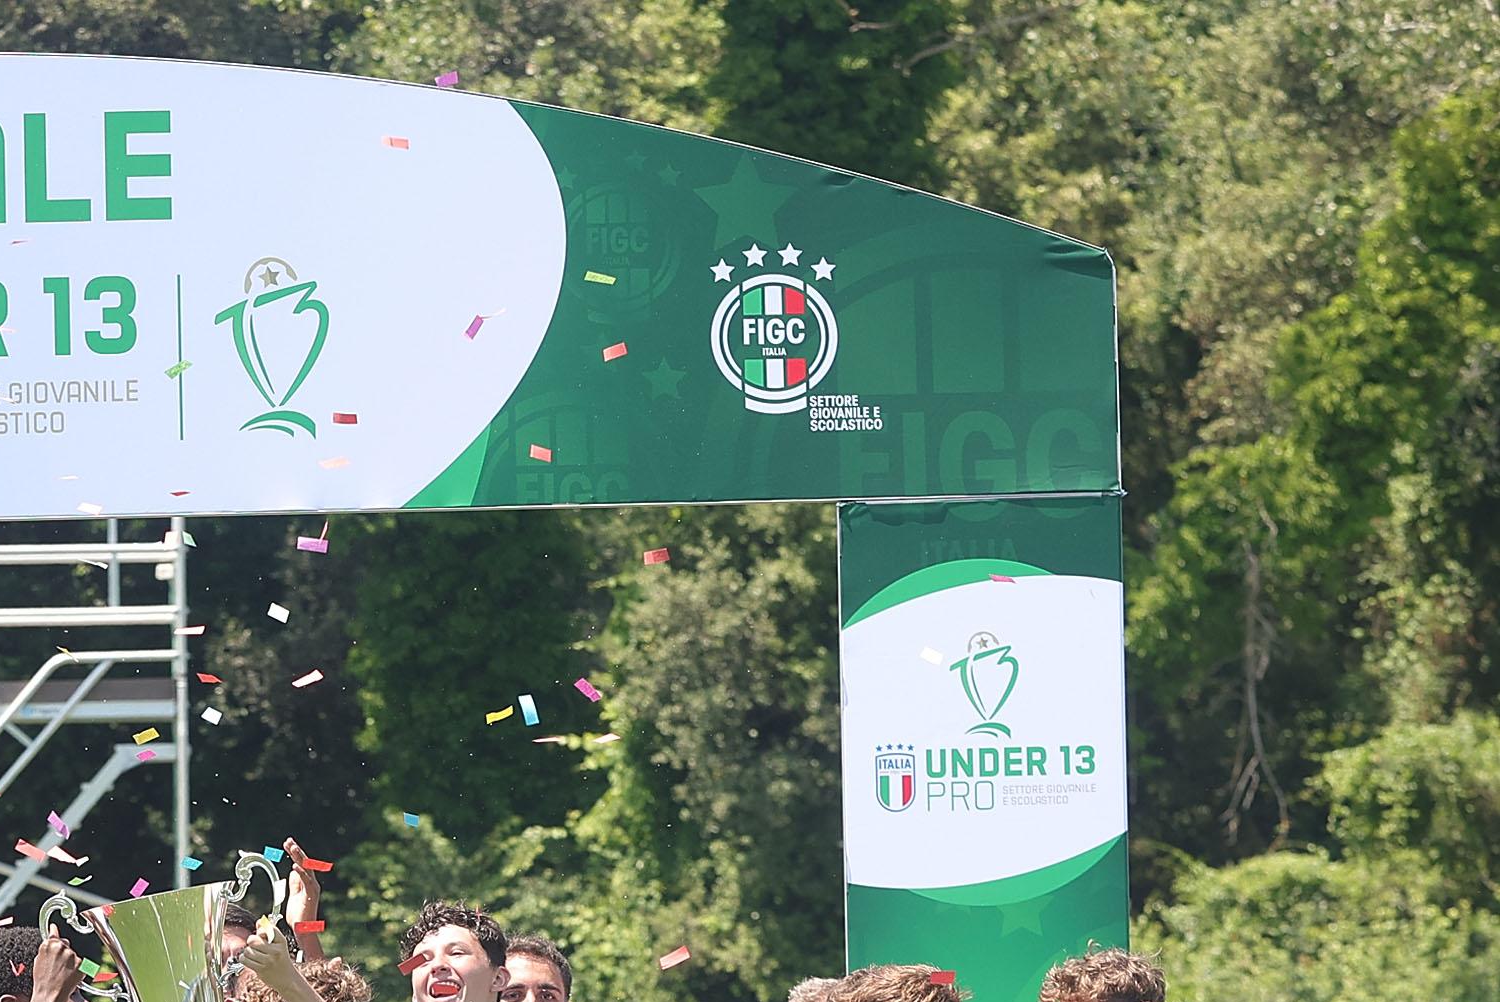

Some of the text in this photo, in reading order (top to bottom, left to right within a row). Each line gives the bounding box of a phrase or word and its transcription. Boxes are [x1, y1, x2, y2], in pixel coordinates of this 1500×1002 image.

[43, 275, 137, 356] 13
[743, 317, 806, 346] FIGC
[762, 347, 787, 356] ITALIA
[8, 380, 139, 404] GIOVANILE
[809, 394, 859, 407] SETTORE
[809, 406, 880, 420] GIOVANILE E
[810, 418, 883, 431] SCOLASTICO
[878, 759, 912, 770] ITALIA
[925, 745, 1096, 778] UNDER 13
[1002, 783, 1097, 795] SETTORE GIOVANILE
[927, 781, 994, 811] PRO
[1002, 796, 1069, 806] E SCOLASTICO
